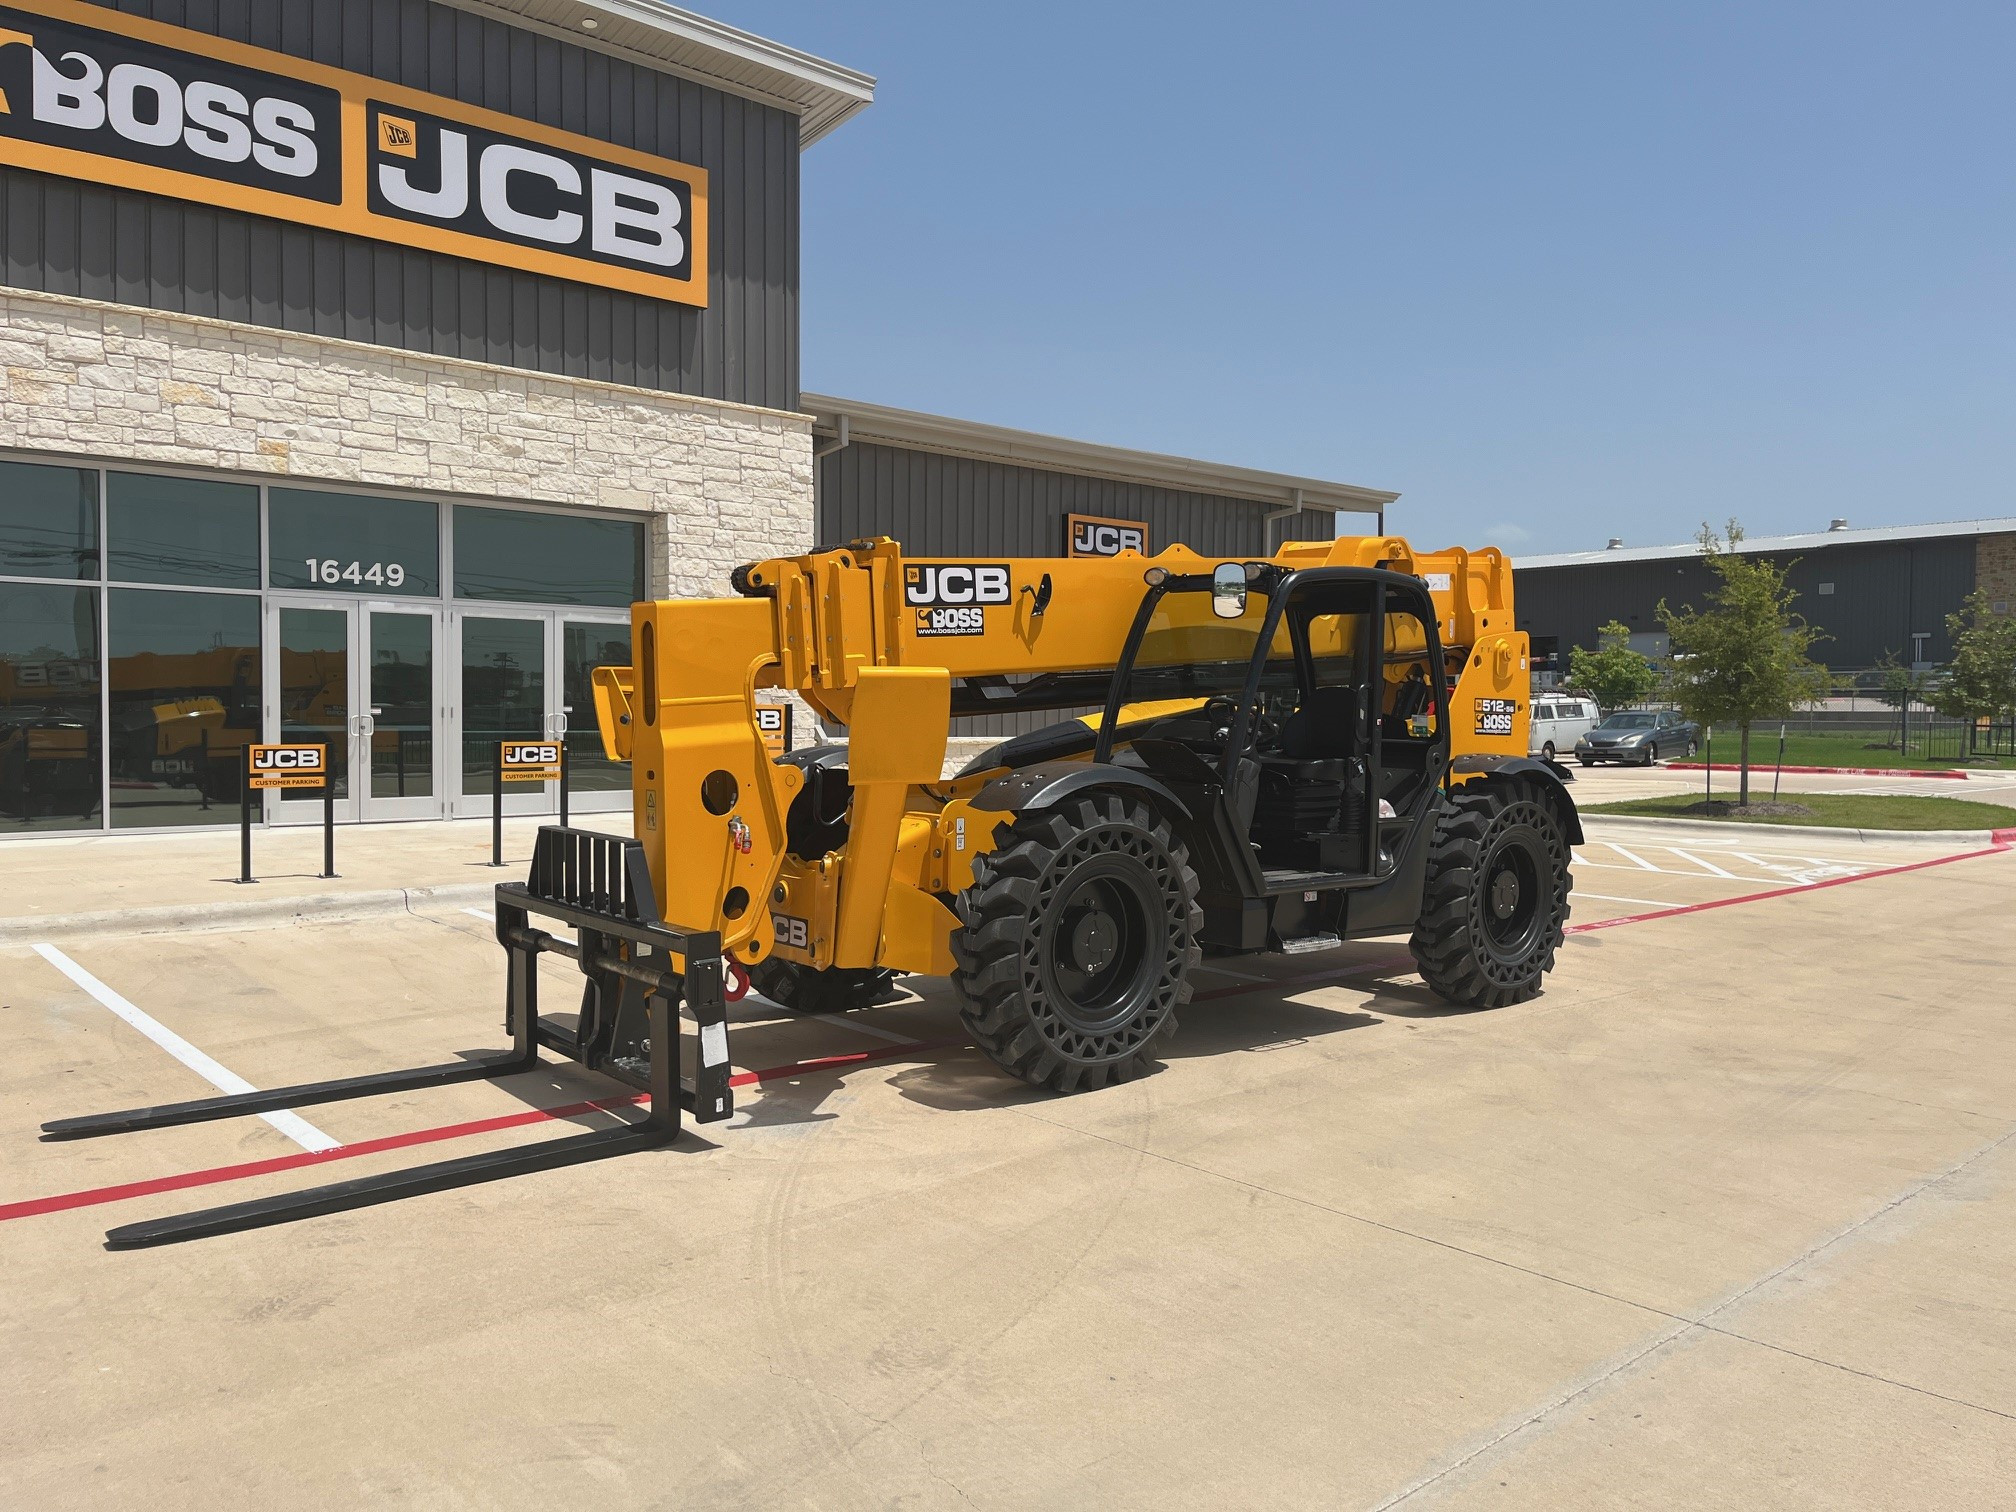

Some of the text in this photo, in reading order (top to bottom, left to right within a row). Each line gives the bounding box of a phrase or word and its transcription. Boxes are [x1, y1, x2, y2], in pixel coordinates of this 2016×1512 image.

[33, 47, 317, 177] BOSS
[388, 124, 410, 144] JCB
[378, 128, 684, 267] JCB
[1075, 525, 1142, 555] JCB
[305, 558, 405, 587] 16449
[908, 567, 1009, 603] JCB
[932, 608, 983, 628] BOSS
[1483, 714, 1511, 729] BOSS
[255, 750, 319, 768] JCB
[505, 746, 557, 763] JCB
[772, 915, 807, 947] CB
